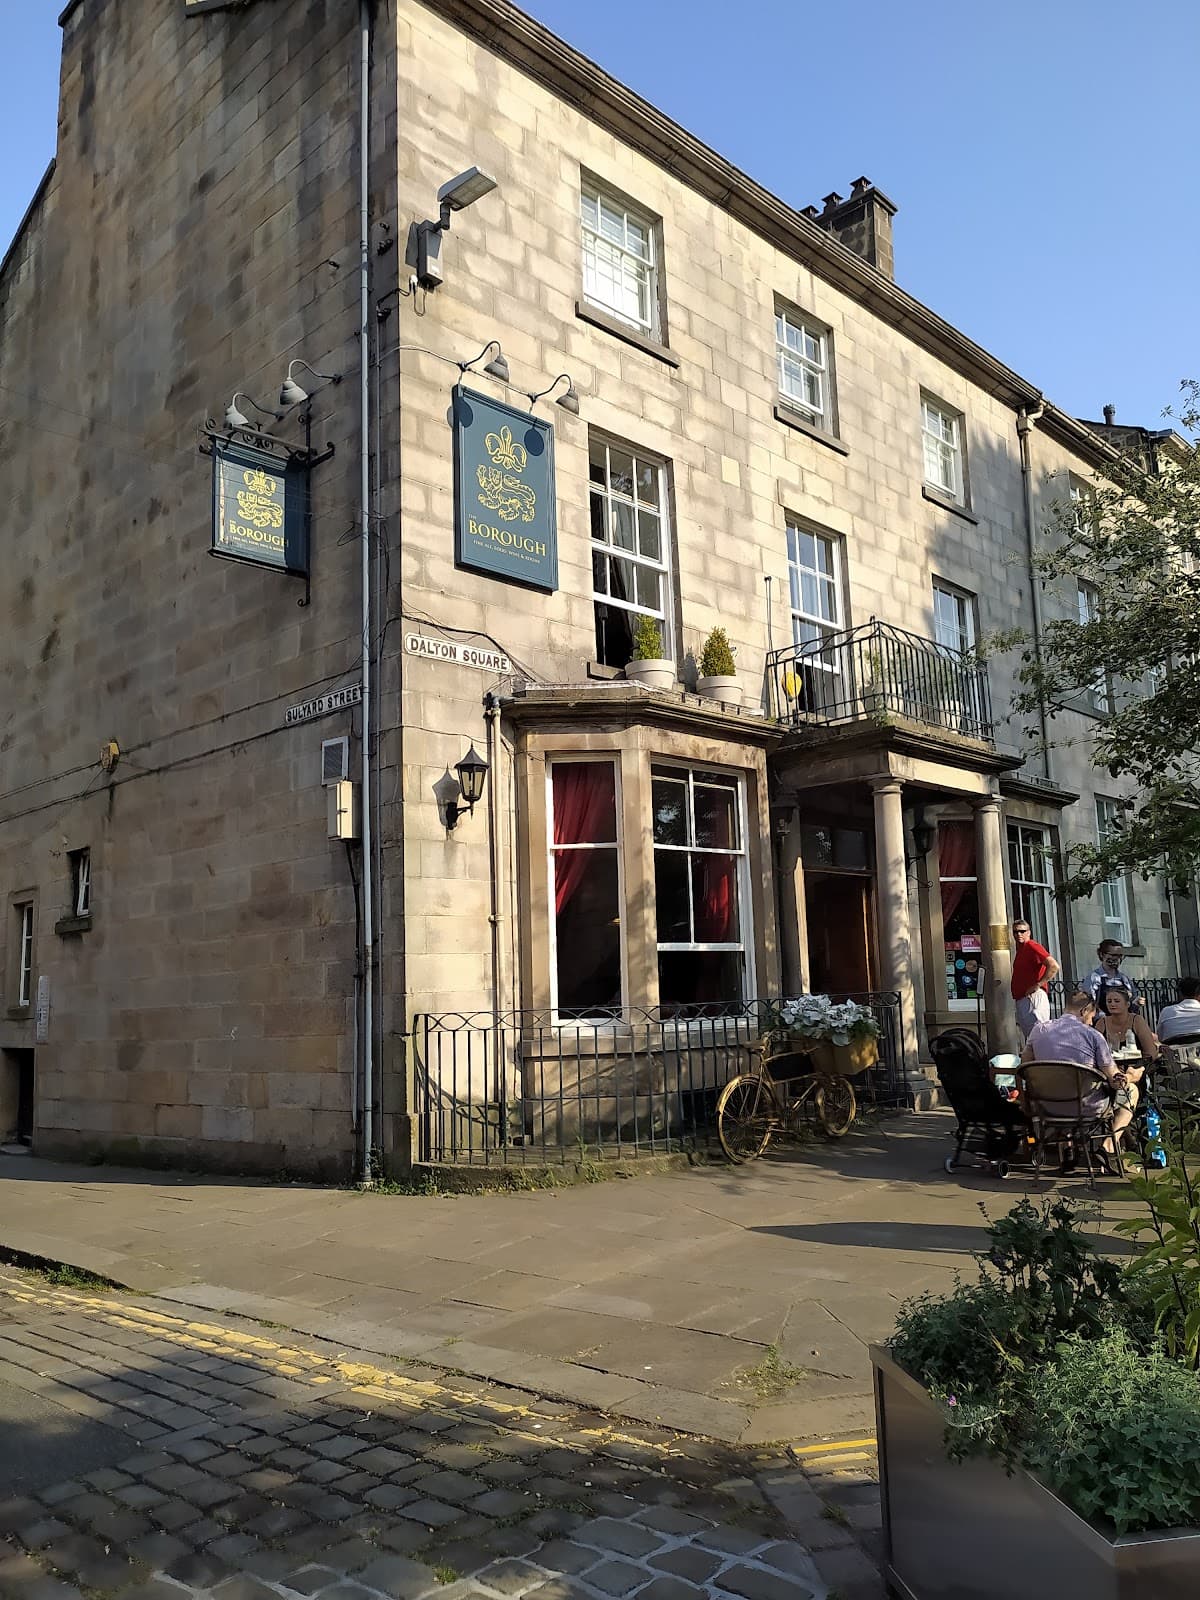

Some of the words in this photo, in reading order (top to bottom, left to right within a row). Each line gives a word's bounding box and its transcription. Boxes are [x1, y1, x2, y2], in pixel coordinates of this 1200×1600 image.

[229, 523, 289, 547] BOROUGH
[469, 519, 546, 557] BOROUGH
[410, 637, 457, 659] DALTON
[463, 649, 508, 671] SQUARE
[287, 699, 324, 722] SULYARD
